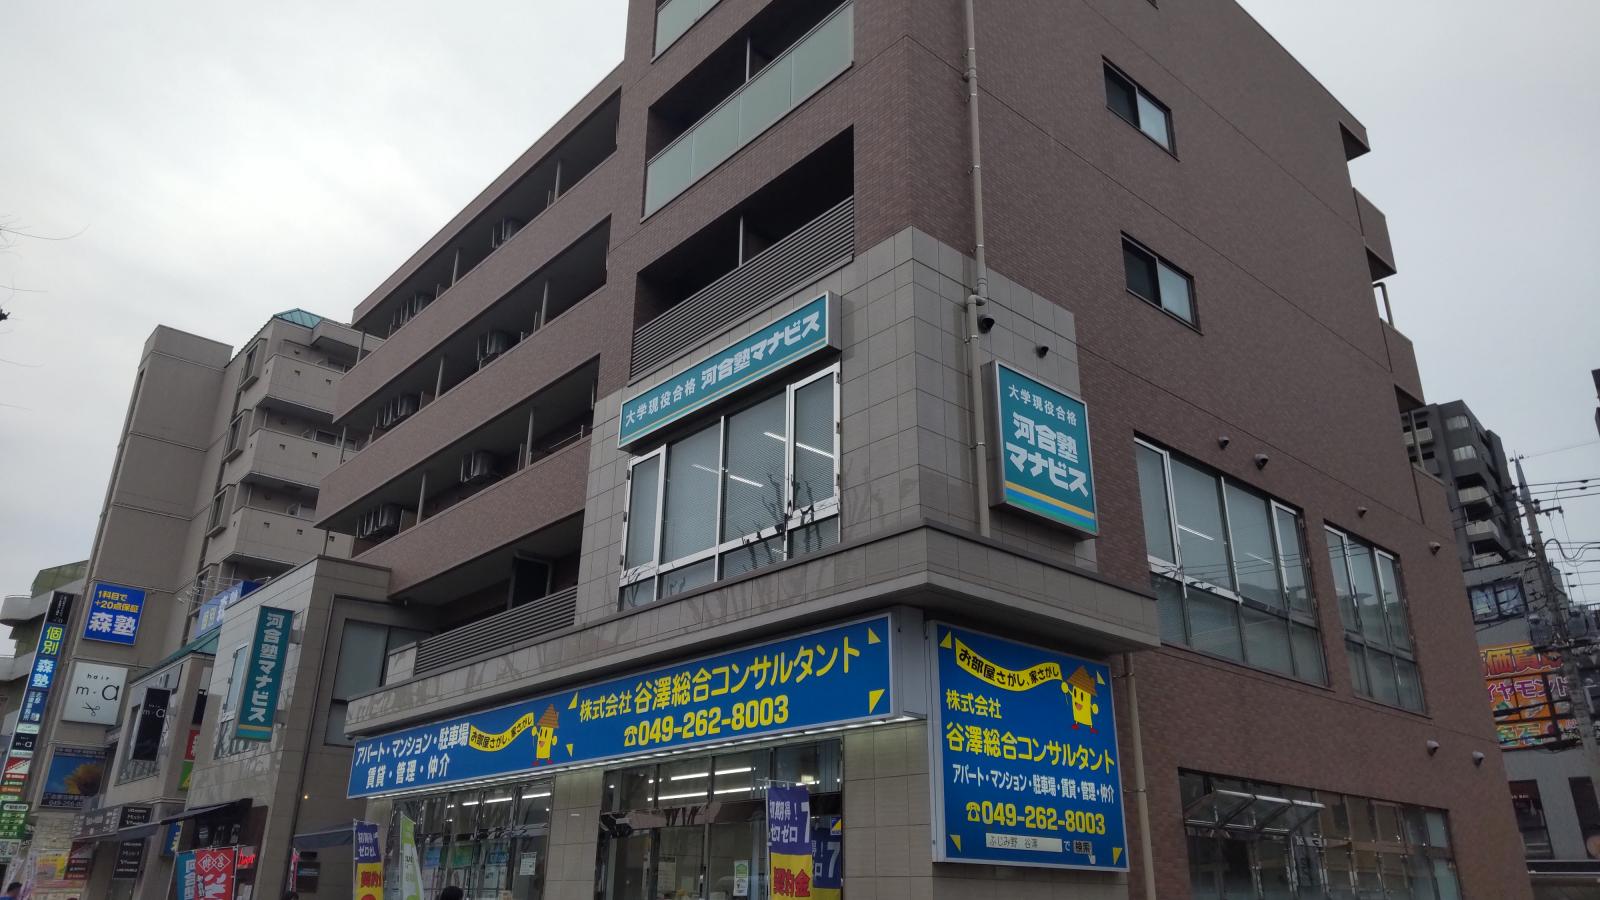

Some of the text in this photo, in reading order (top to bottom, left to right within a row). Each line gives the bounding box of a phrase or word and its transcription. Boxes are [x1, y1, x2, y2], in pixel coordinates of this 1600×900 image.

[625, 310, 821, 428] 大学現役合格 河合塾マナビス
[1008, 384, 1077, 427] 大学現役合格
[1012, 411, 1079, 464] 河合塾
[1006, 442, 1088, 498] マナビス
[41, 626, 63, 655] 個別
[88, 612, 136, 636] 森塾
[32, 659, 54, 688] 森塾
[945, 689, 1002, 719] 株式会社
[945, 721, 1116, 775] 谷澤総合コンサルタント
[365, 752, 450, 789] 賃貸・管理・仲介
